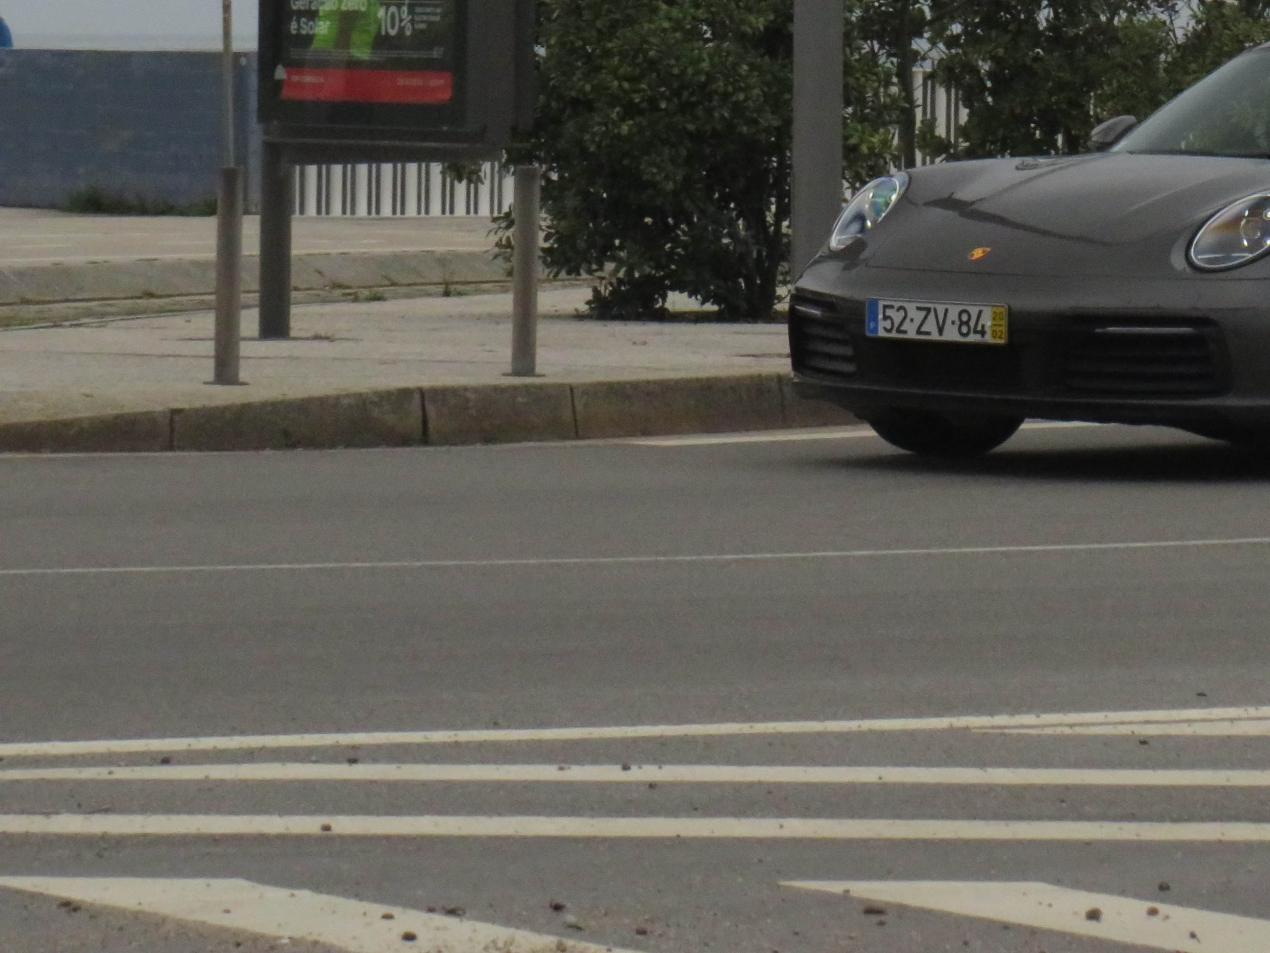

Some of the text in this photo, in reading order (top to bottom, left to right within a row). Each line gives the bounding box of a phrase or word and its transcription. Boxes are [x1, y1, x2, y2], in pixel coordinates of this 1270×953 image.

[301, 17, 330, 35] Solar
[377, 5, 412, 36] 10%
[991, 329, 1004, 339] 02
